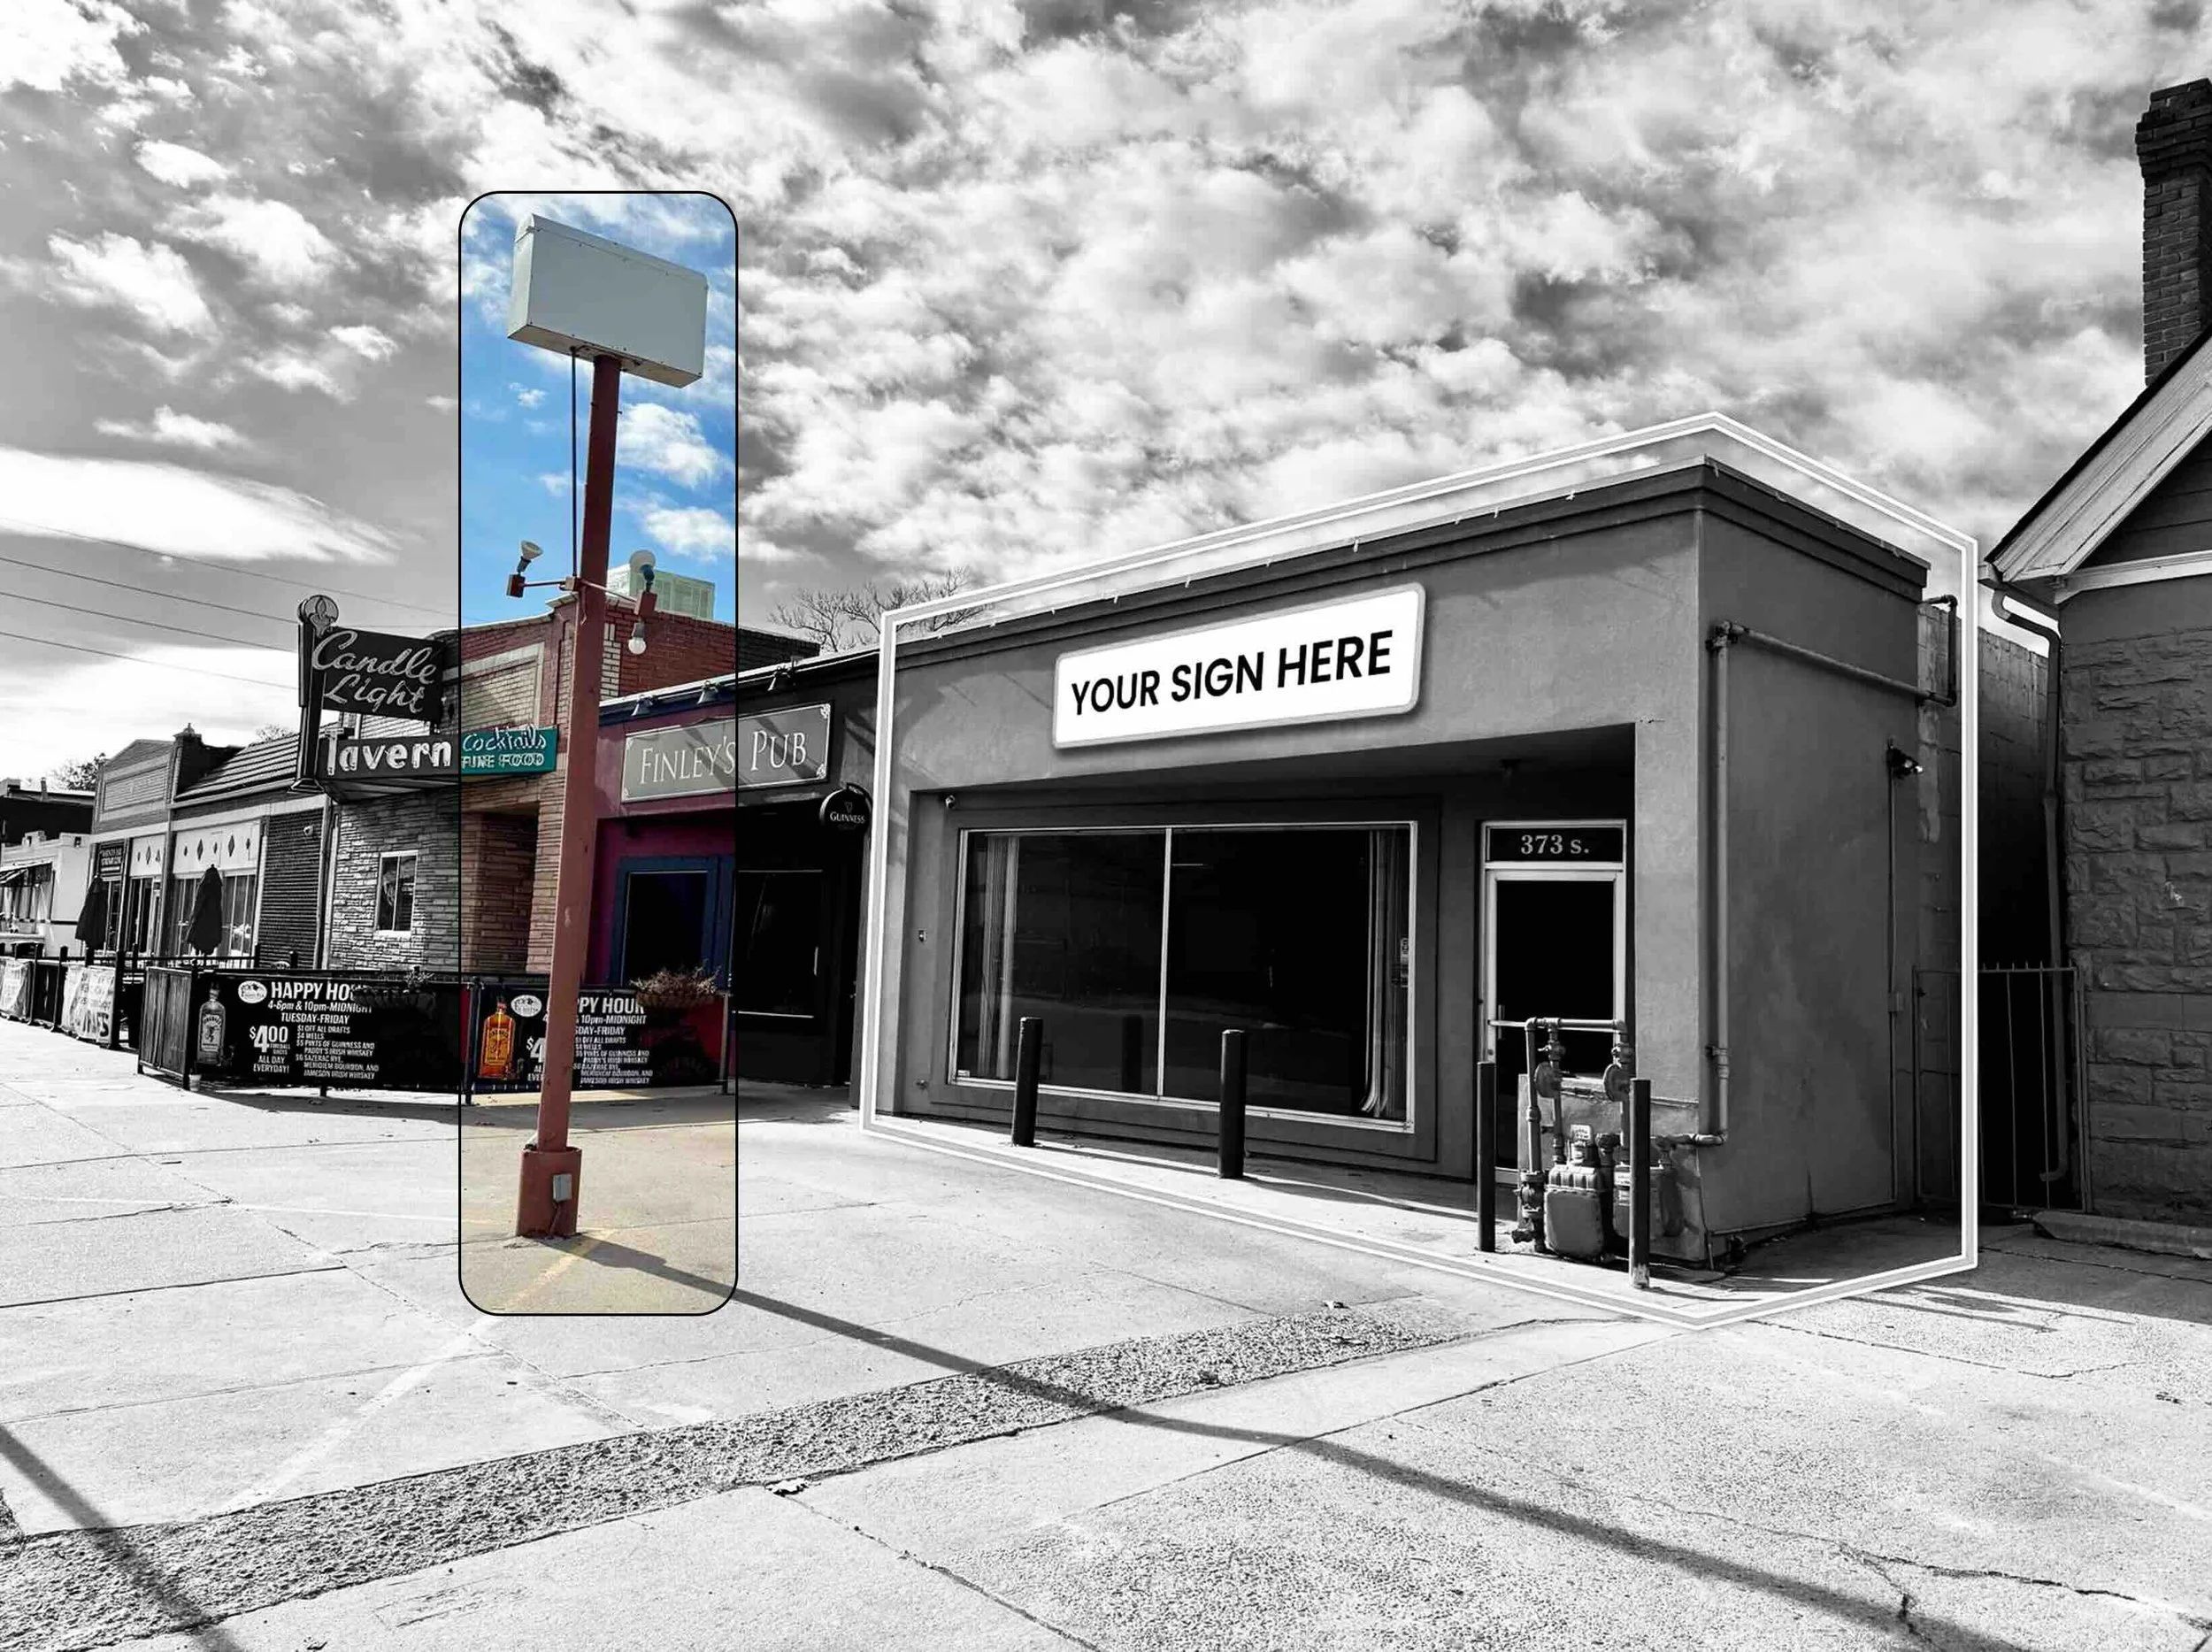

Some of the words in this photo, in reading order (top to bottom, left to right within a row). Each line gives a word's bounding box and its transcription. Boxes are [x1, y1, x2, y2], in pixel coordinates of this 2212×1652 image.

[311, 630, 436, 684] Candle
[325, 673, 425, 713] Light
[462, 724, 547, 752] Cocktails
[324, 727, 451, 776] Tavern
[460, 755, 495, 769] FINE
[499, 752, 544, 768] FOOD
[641, 735, 736, 784] FINLEY'S
[750, 730, 806, 772] PUB
[830, 811, 865, 824] GUINNESS
[1520, 834, 1563, 855] 373
[271, 981, 323, 1000] HAPPY
[326, 982, 355, 1001] HO
[296, 1001, 303, 1010] &
[281, 1012, 349, 1025] TUESDAY-FRIDAY
